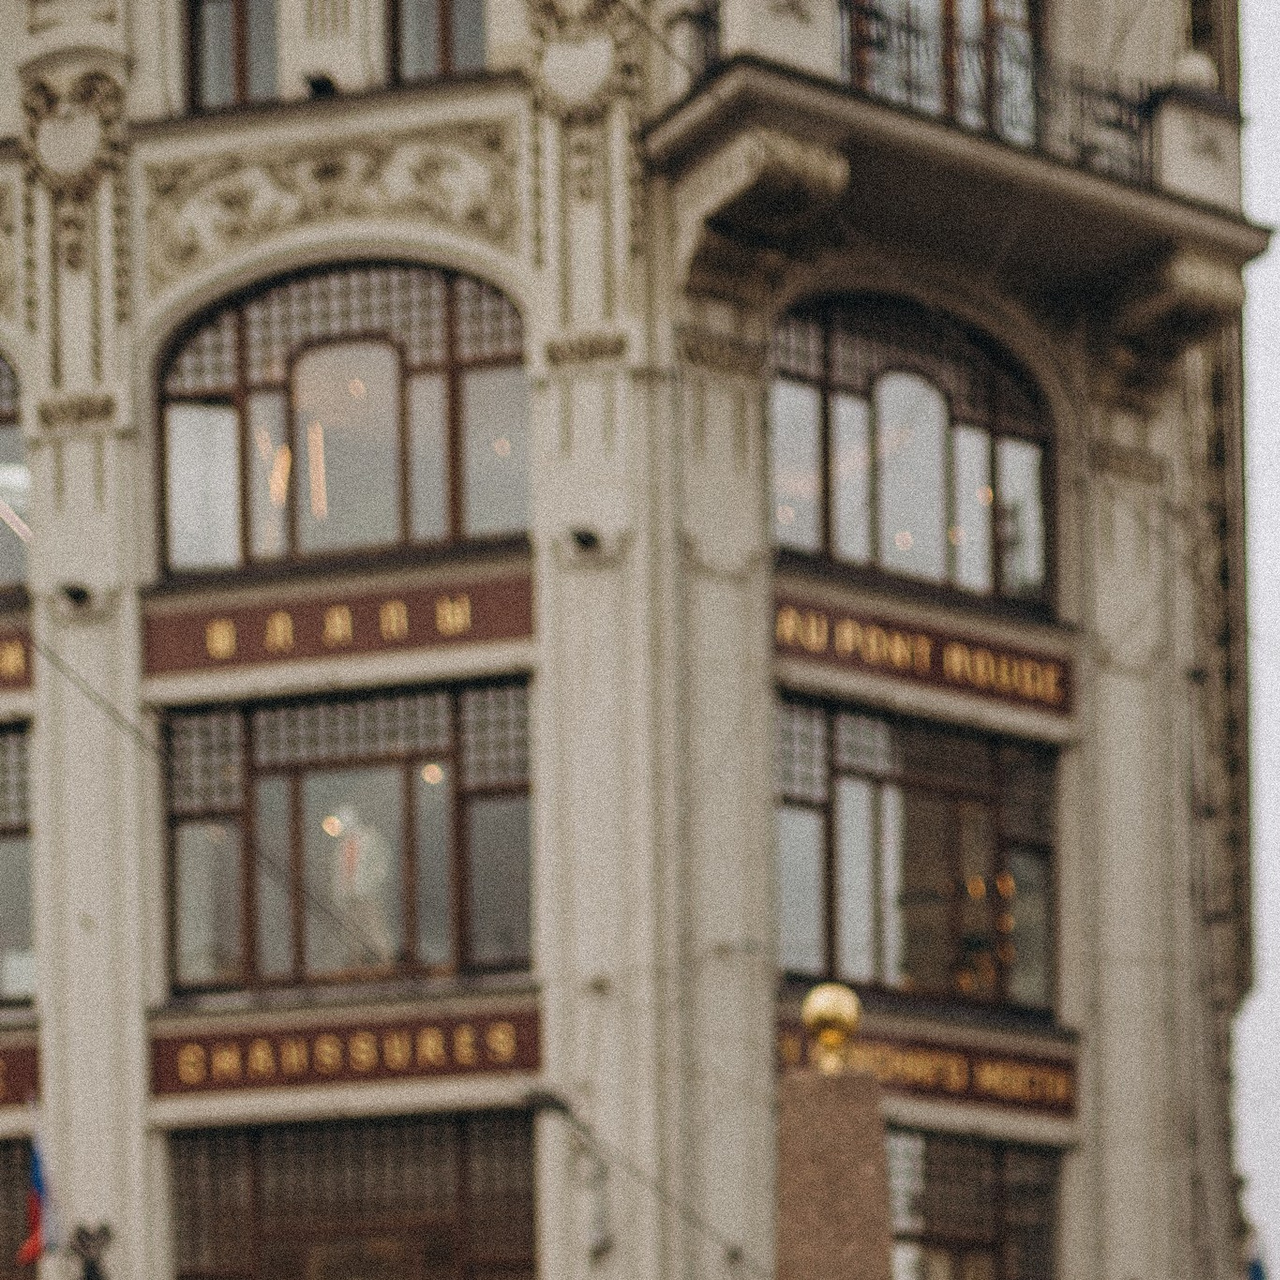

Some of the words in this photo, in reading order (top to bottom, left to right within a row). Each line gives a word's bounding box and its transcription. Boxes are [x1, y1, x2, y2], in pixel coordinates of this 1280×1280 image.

[777, 605, 829, 653] AU
[834, 618, 932, 675] PONT
[943, 641, 1063, 704] ROUGE
[177, 1020, 517, 1085] CHAUSSURES
